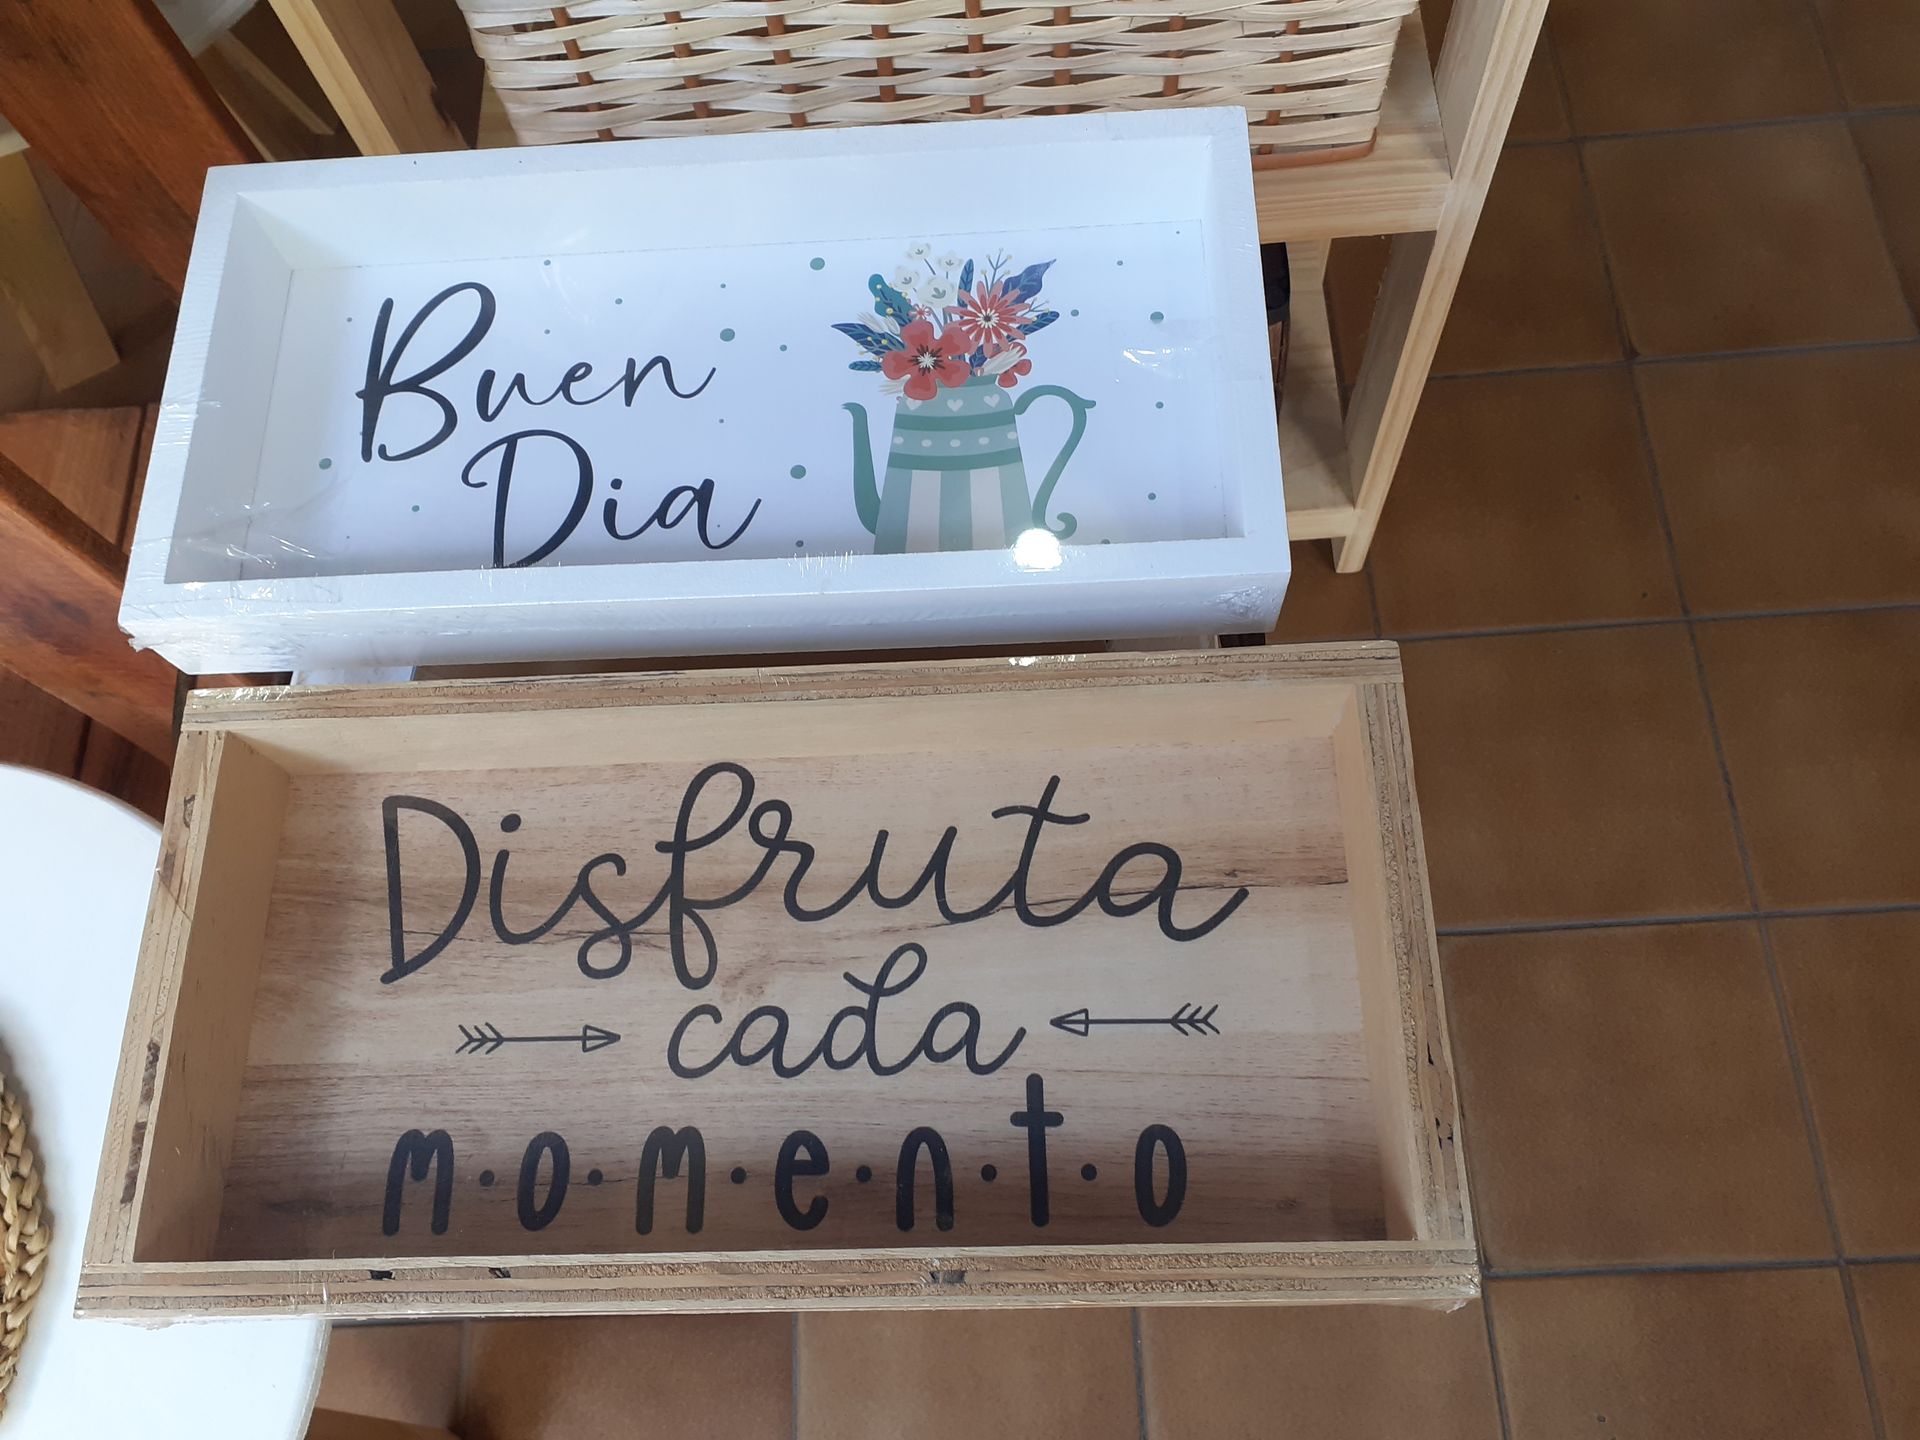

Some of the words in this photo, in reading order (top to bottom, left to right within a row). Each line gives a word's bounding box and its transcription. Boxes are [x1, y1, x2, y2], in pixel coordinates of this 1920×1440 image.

[356, 283, 716, 462] Buen
[462, 430, 762, 569] Dia
[381, 763, 1250, 990] Disfruta
[668, 943, 1027, 1079] cada
